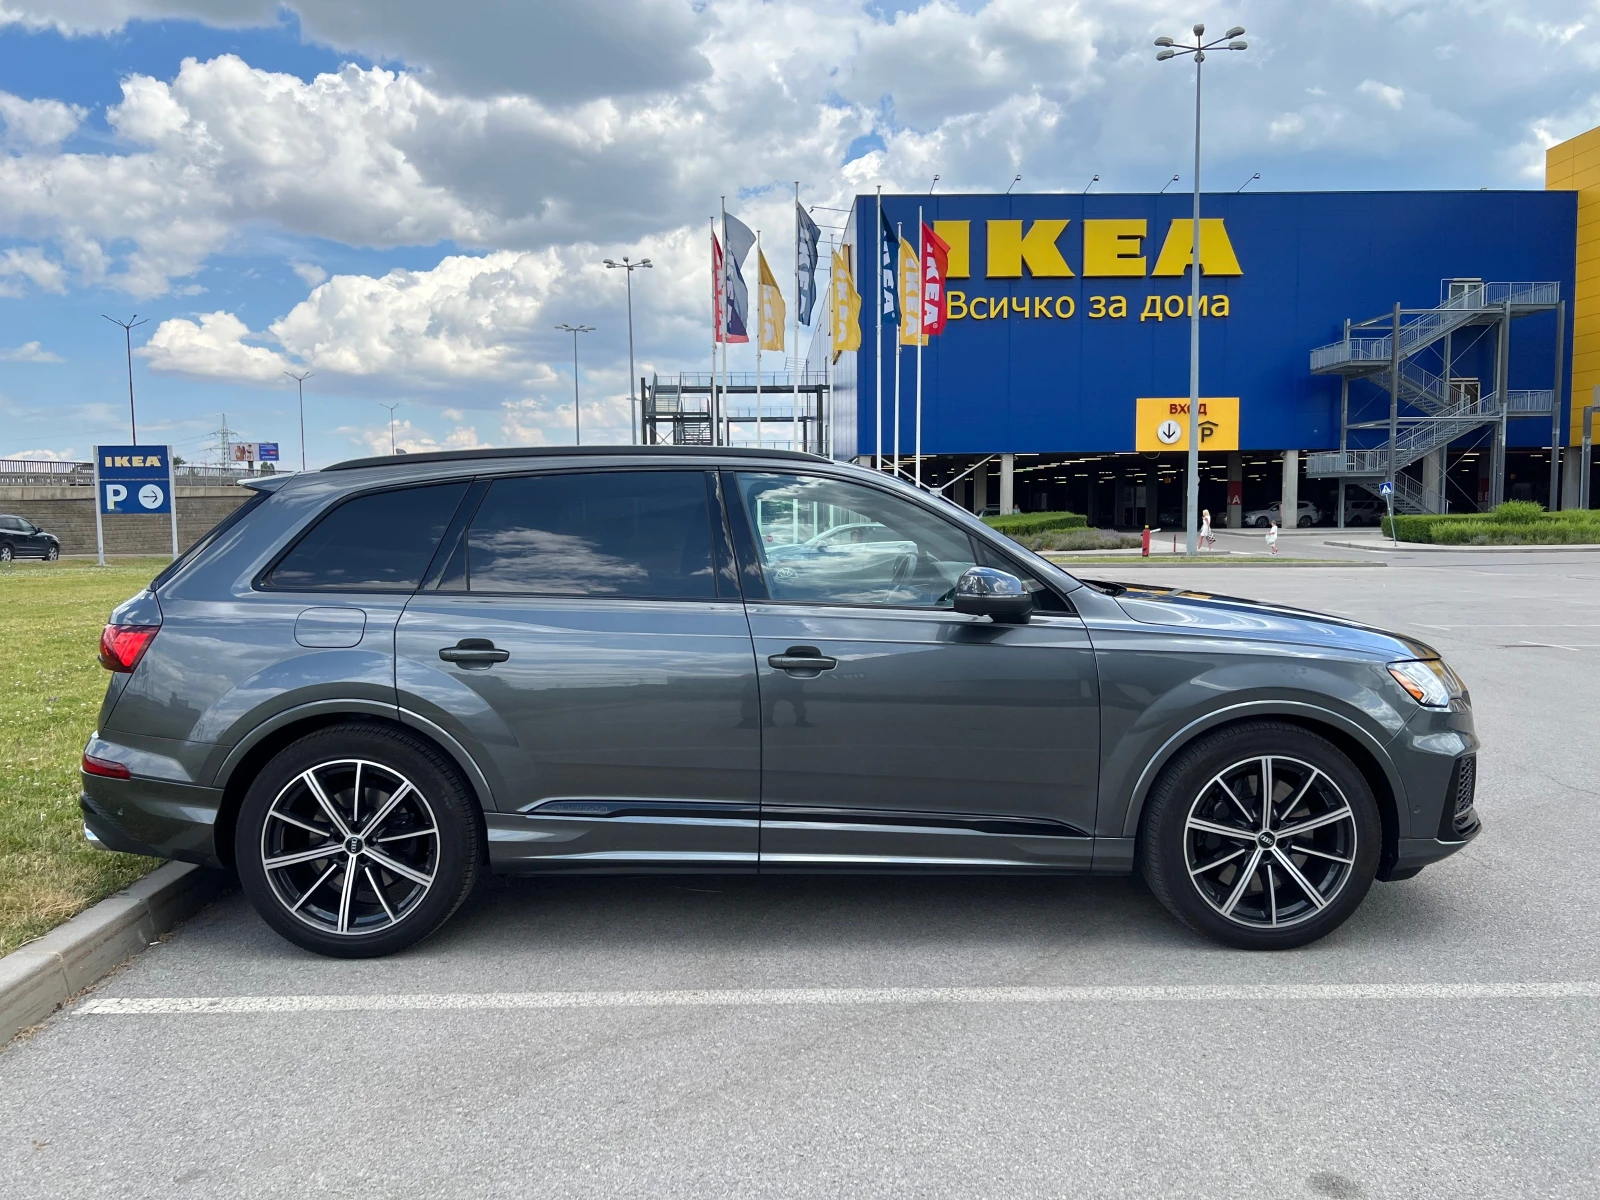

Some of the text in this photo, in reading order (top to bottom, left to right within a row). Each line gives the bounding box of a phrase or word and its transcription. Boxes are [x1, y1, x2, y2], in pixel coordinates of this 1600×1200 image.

[933, 218, 1244, 278] IKEA
[883, 230, 894, 315] KEA
[837, 268, 849, 343] IKEA
[947, 290, 1230, 322] Всичко за дома
[1169, 403, 1207, 416] ВХД
[104, 455, 161, 467] IKEA
[106, 484, 127, 510] P
